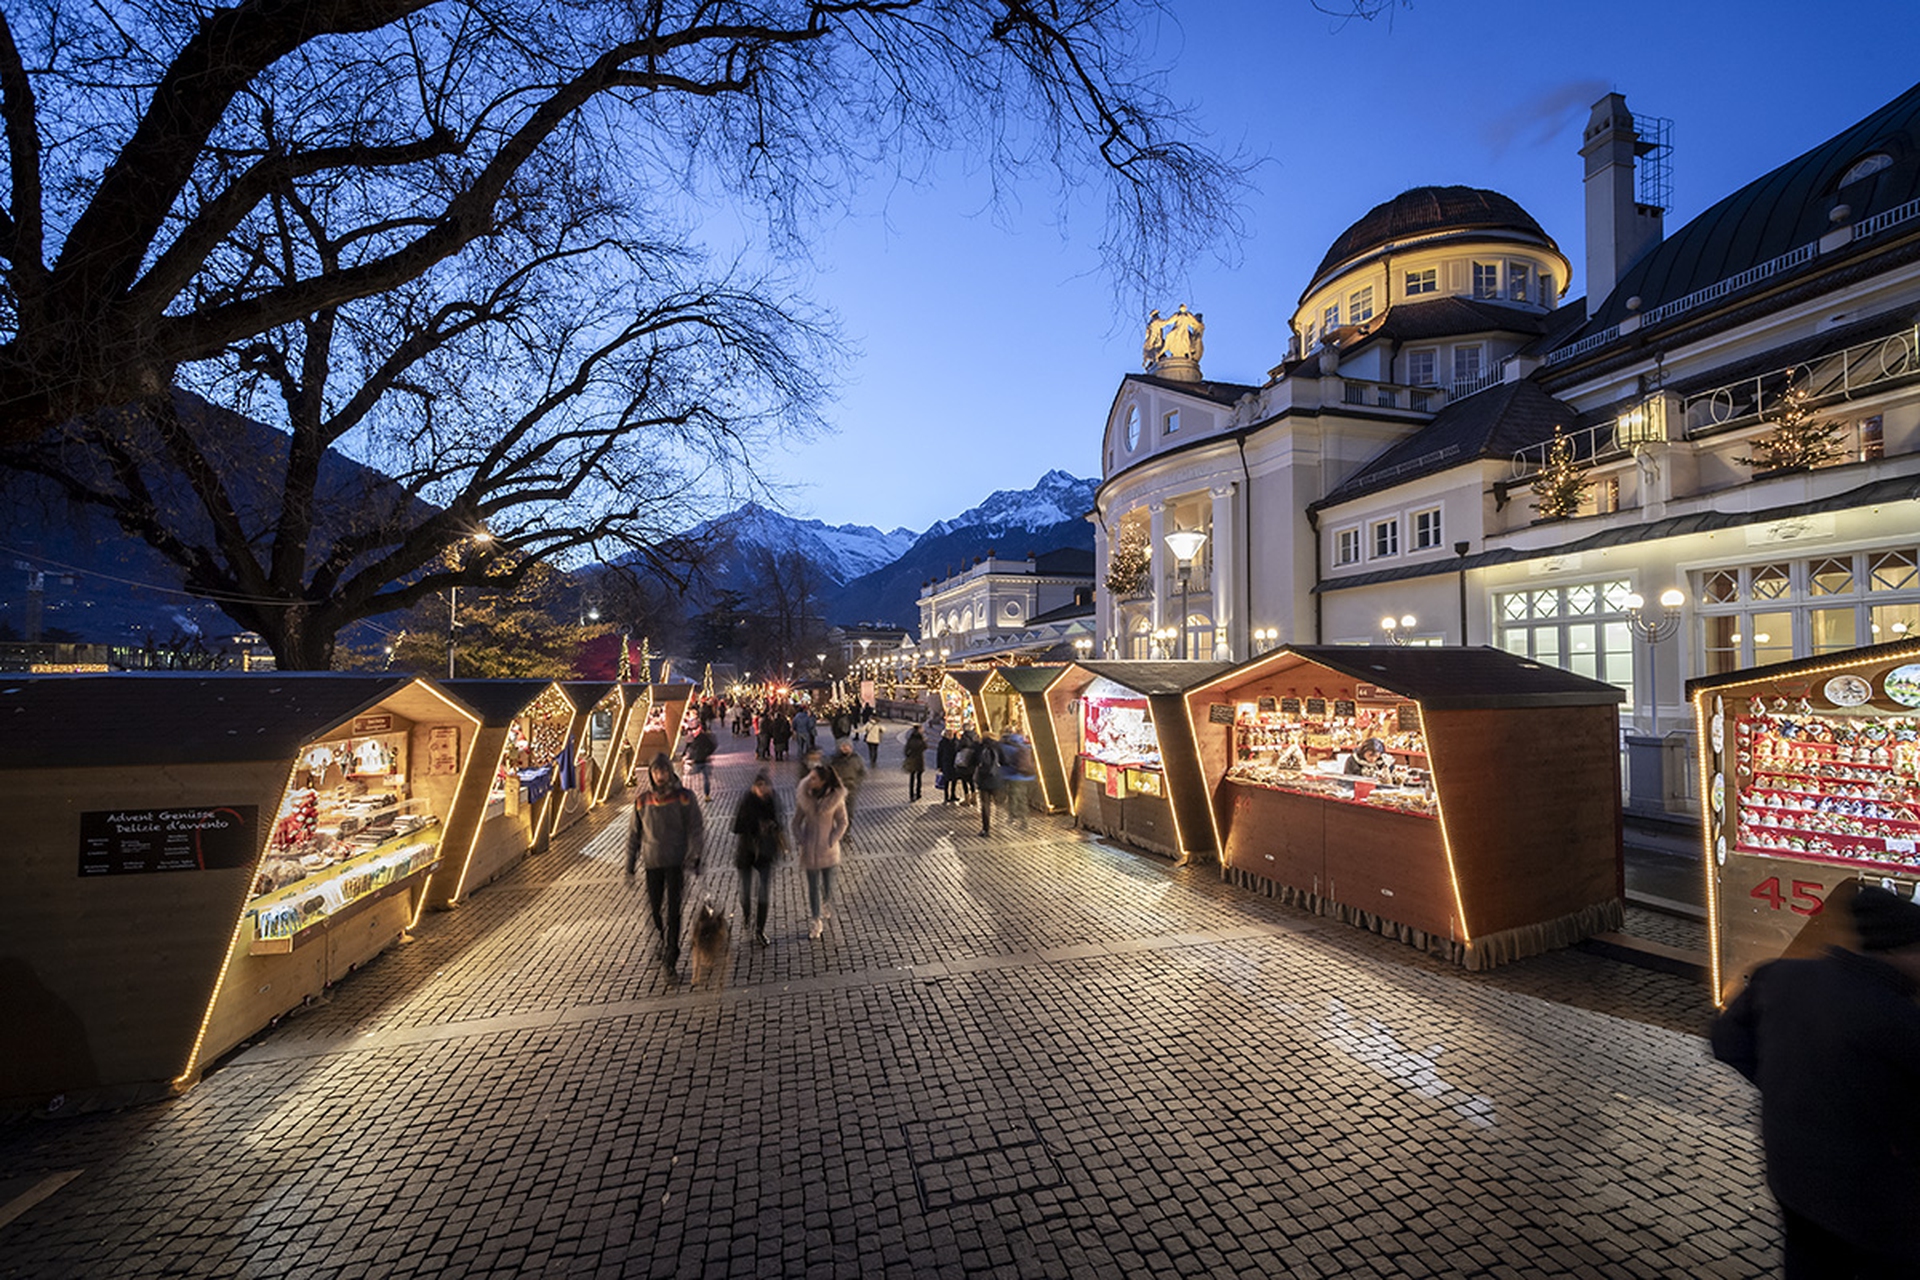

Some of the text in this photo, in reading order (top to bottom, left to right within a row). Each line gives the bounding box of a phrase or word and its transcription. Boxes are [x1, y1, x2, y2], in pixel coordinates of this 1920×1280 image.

[107, 809, 216, 824] Advent Genüsse
[116, 820, 229, 834] Delizie d'avvento
[1750, 876, 1825, 916] 45
